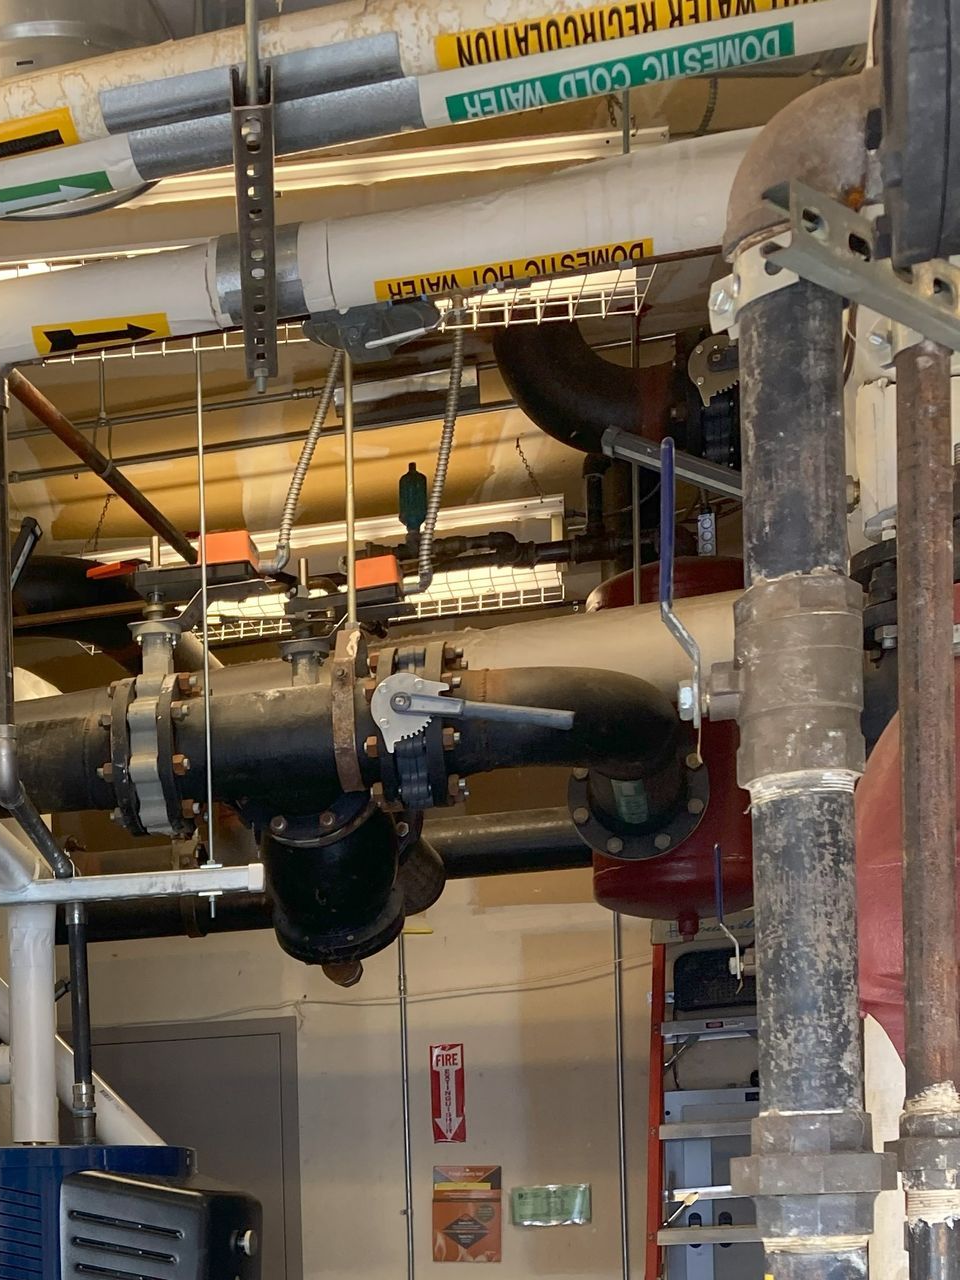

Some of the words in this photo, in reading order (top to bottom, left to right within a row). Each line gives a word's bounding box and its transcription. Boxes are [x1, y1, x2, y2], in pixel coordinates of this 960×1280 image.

[456, 1, 656, 68] RECIRCULATION
[642, 29, 780, 84] DOMESTIC
[463, 80, 549, 119] WATER
[558, 62, 632, 100] COLD
[525, 242, 644, 275] DOMESTIC
[436, 1053, 458, 1067] FIRE
